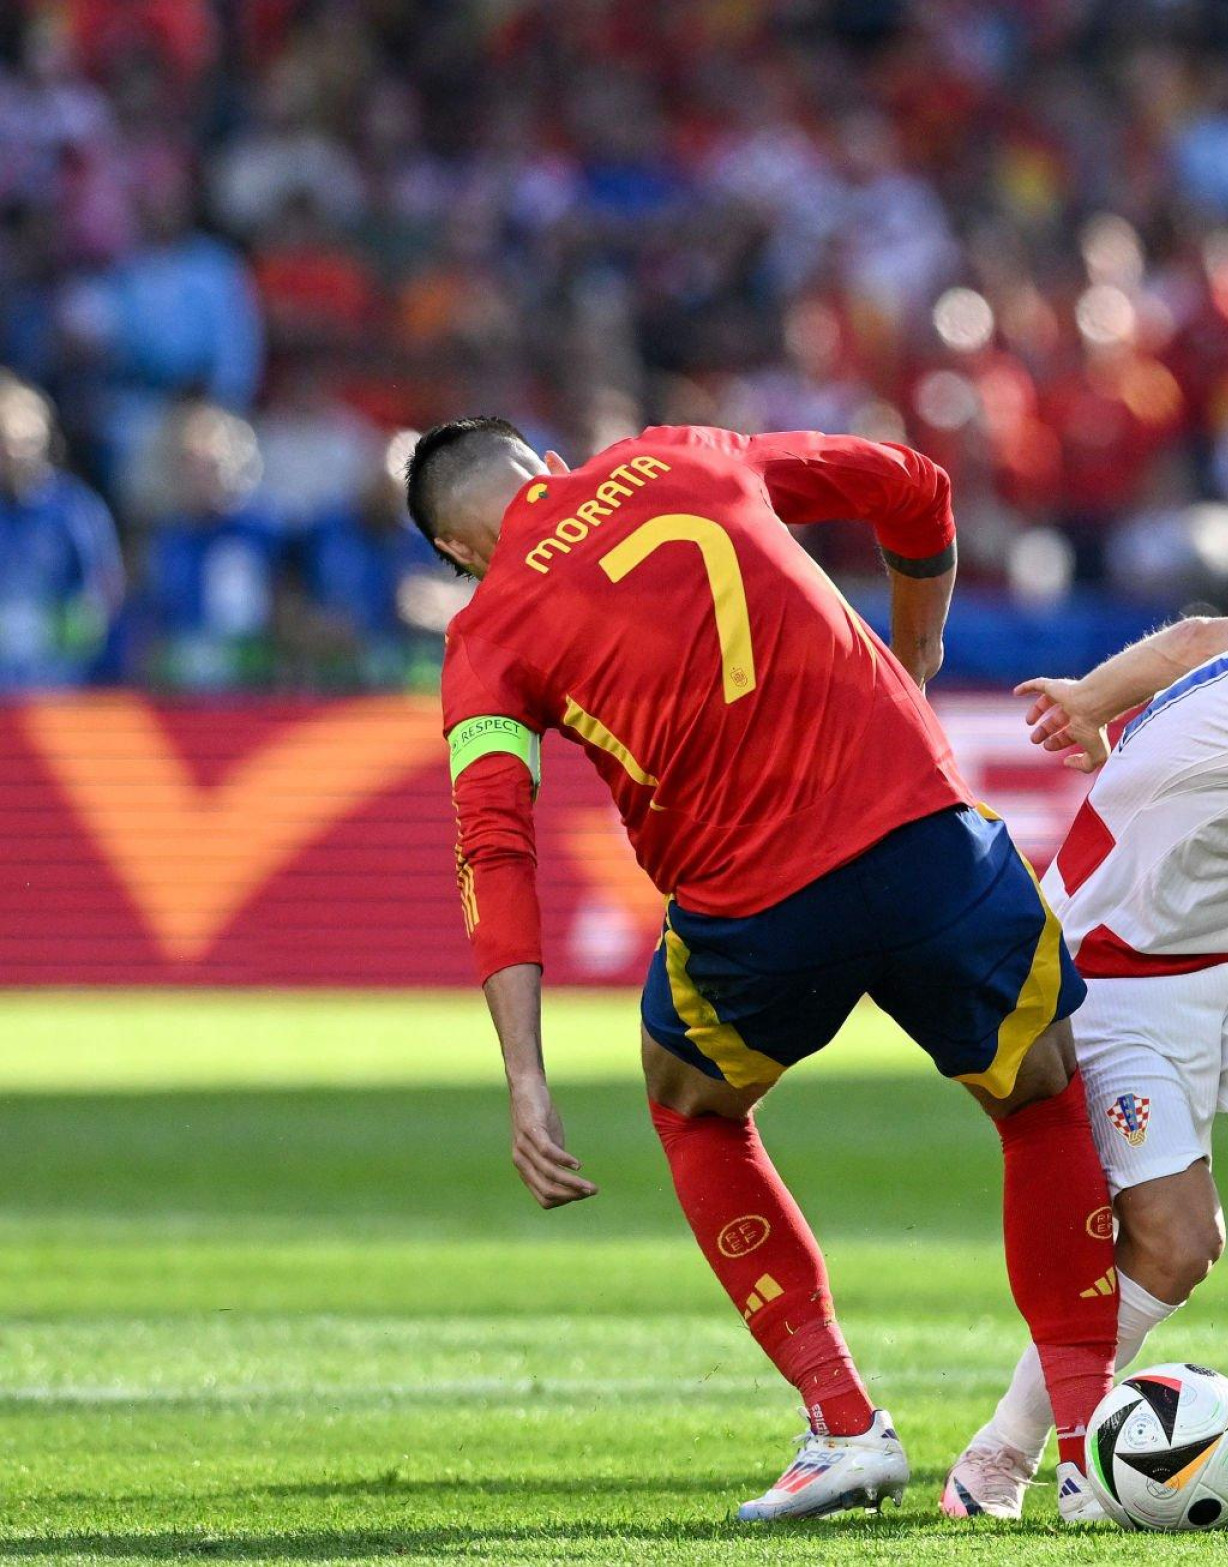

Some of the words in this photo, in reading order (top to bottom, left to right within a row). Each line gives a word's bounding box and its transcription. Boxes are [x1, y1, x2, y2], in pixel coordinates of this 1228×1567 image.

[525, 456, 671, 574] MORATA
[600, 513, 757, 705] 7
[461, 718, 521, 742] RESPECT
